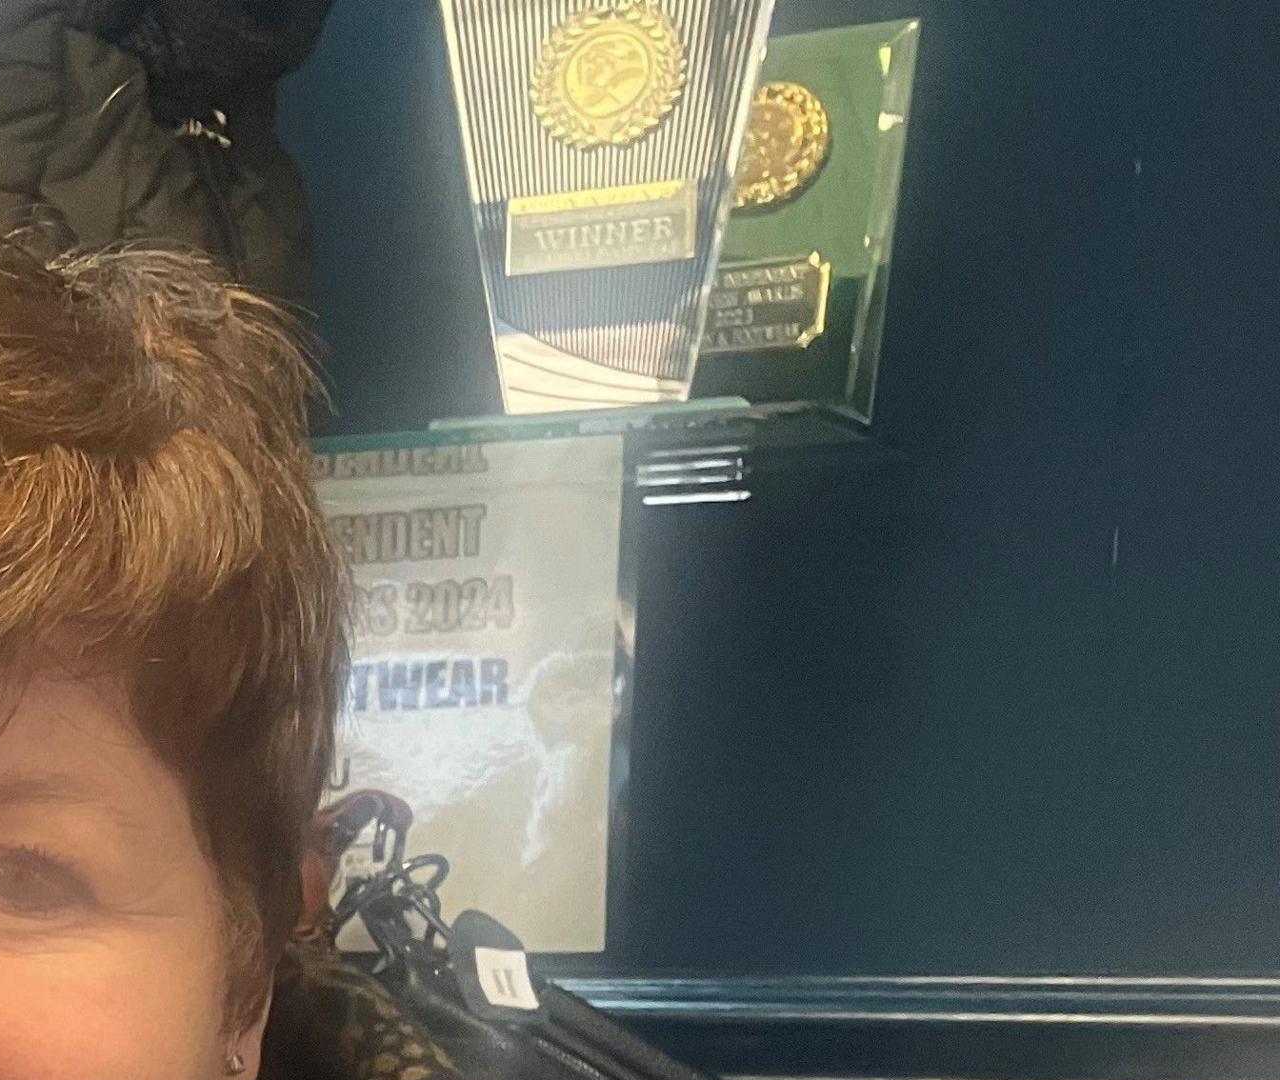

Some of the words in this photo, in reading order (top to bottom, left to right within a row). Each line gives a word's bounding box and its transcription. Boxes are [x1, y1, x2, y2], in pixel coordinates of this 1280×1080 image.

[533, 216, 674, 250] WINNER
[404, 574, 515, 634] 2024
[351, 657, 509, 712] TWEAR
